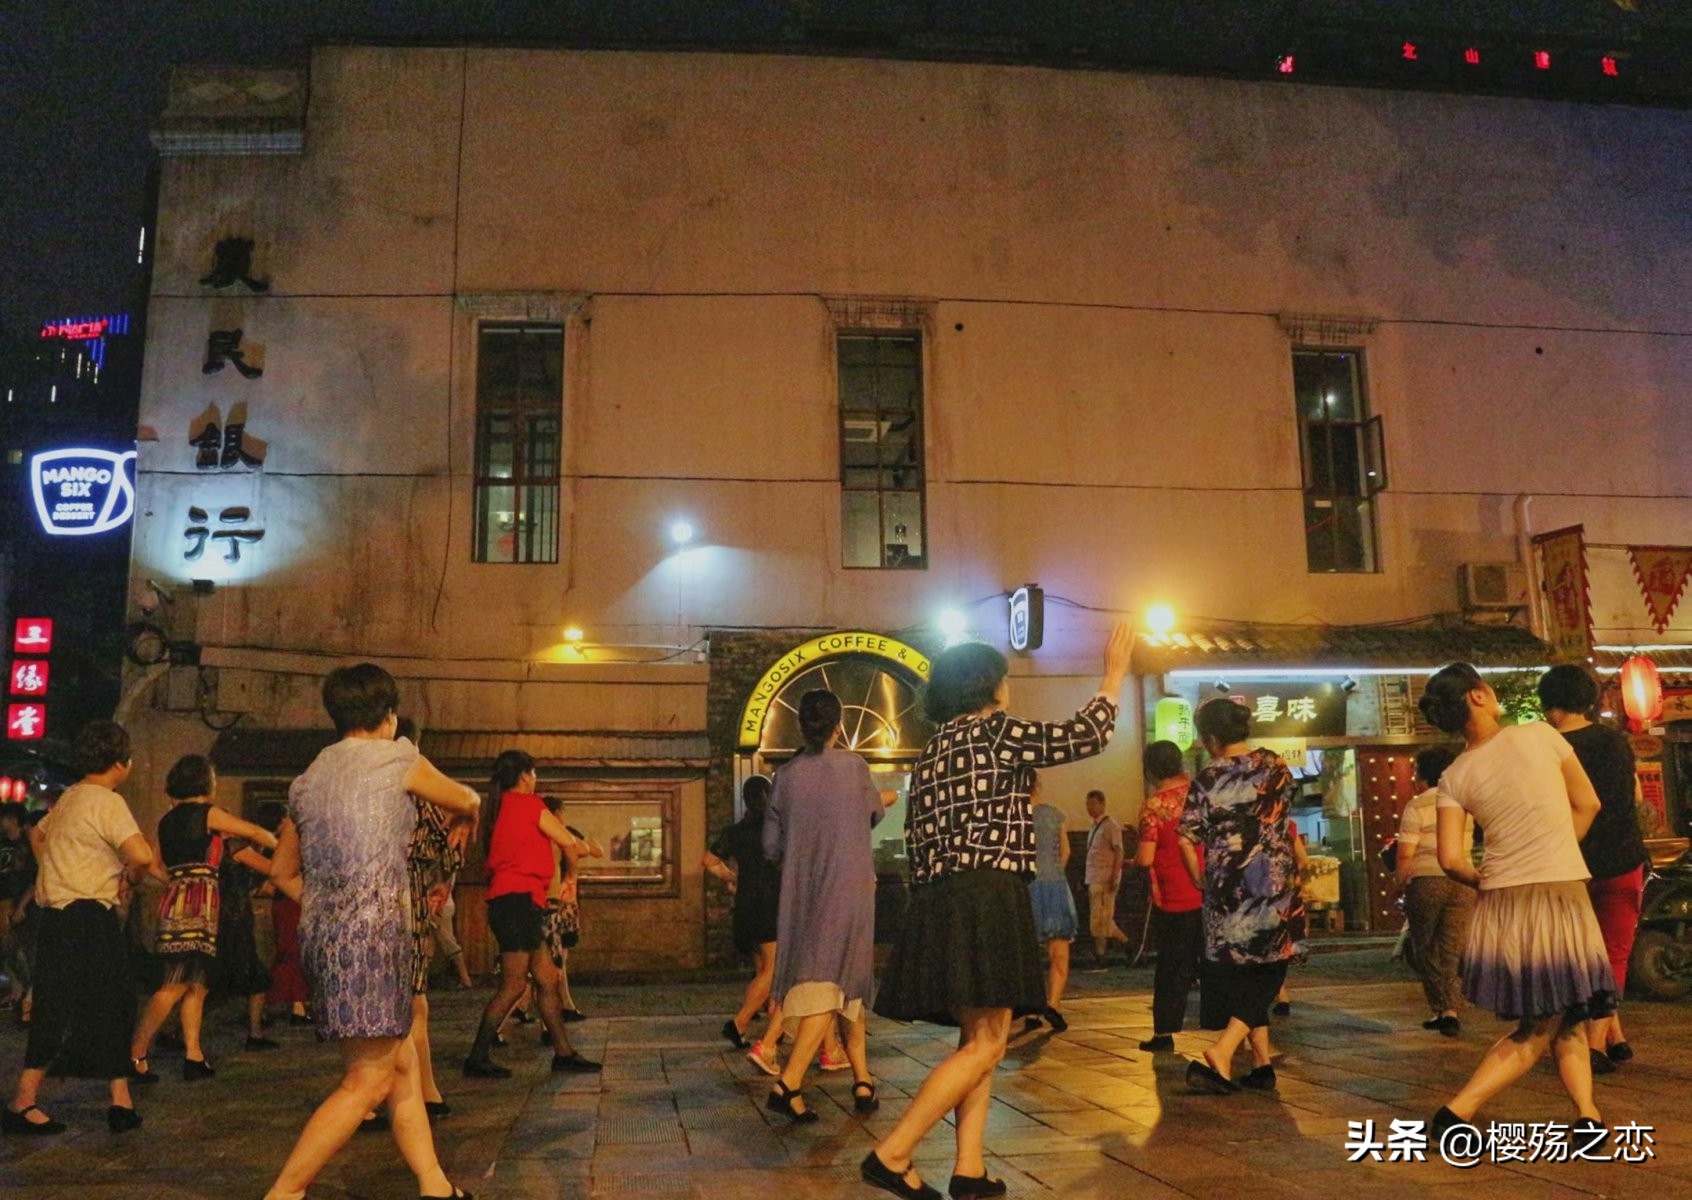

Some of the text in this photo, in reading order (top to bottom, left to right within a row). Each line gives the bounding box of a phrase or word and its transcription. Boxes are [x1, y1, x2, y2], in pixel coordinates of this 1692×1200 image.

[42, 467, 111, 485] MANGO
[60, 482, 92, 497] SIX
[745, 650, 806, 732] MANGOSIX
[818, 635, 888, 652] COFFEE
